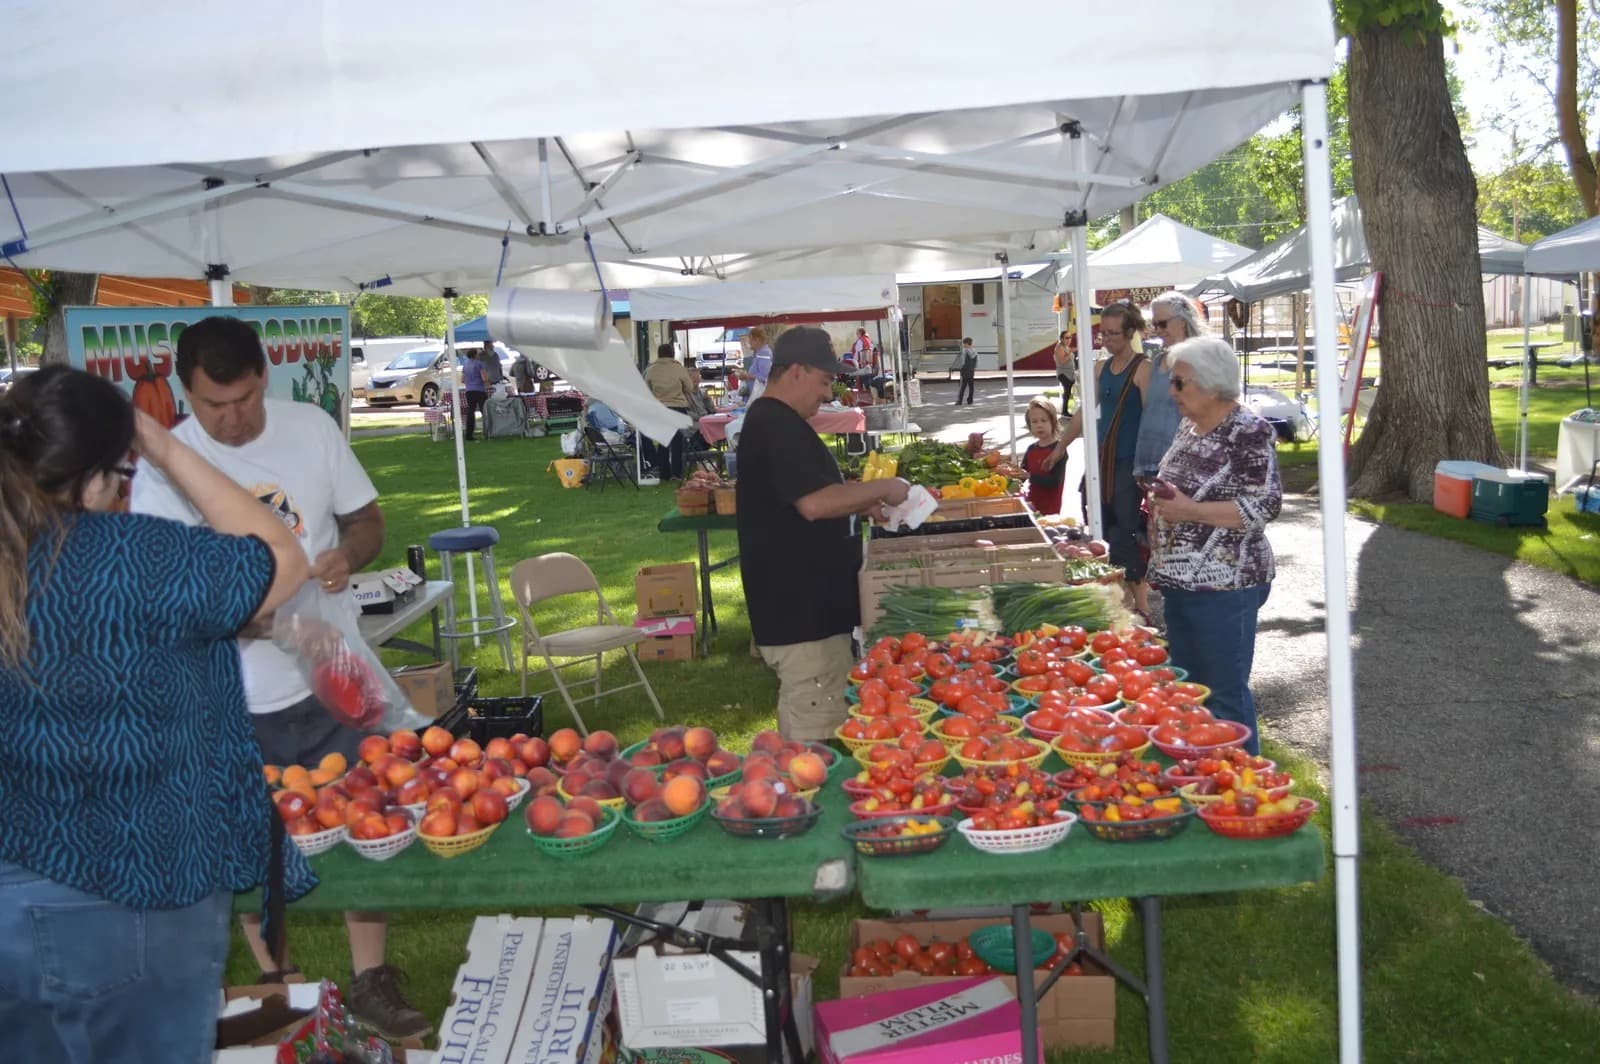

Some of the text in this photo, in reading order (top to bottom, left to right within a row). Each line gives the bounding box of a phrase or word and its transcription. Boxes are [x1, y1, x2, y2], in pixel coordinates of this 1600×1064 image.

[246, 317, 343, 367] ODUCE
[487, 931, 525, 1017] PREMIUM
[532, 931, 573, 1034] CALIFORNIA
[440, 974, 496, 1064] FRUIT
[879, 1000, 953, 1029] PLUM
[882, 1002, 980, 1039] MISTER
